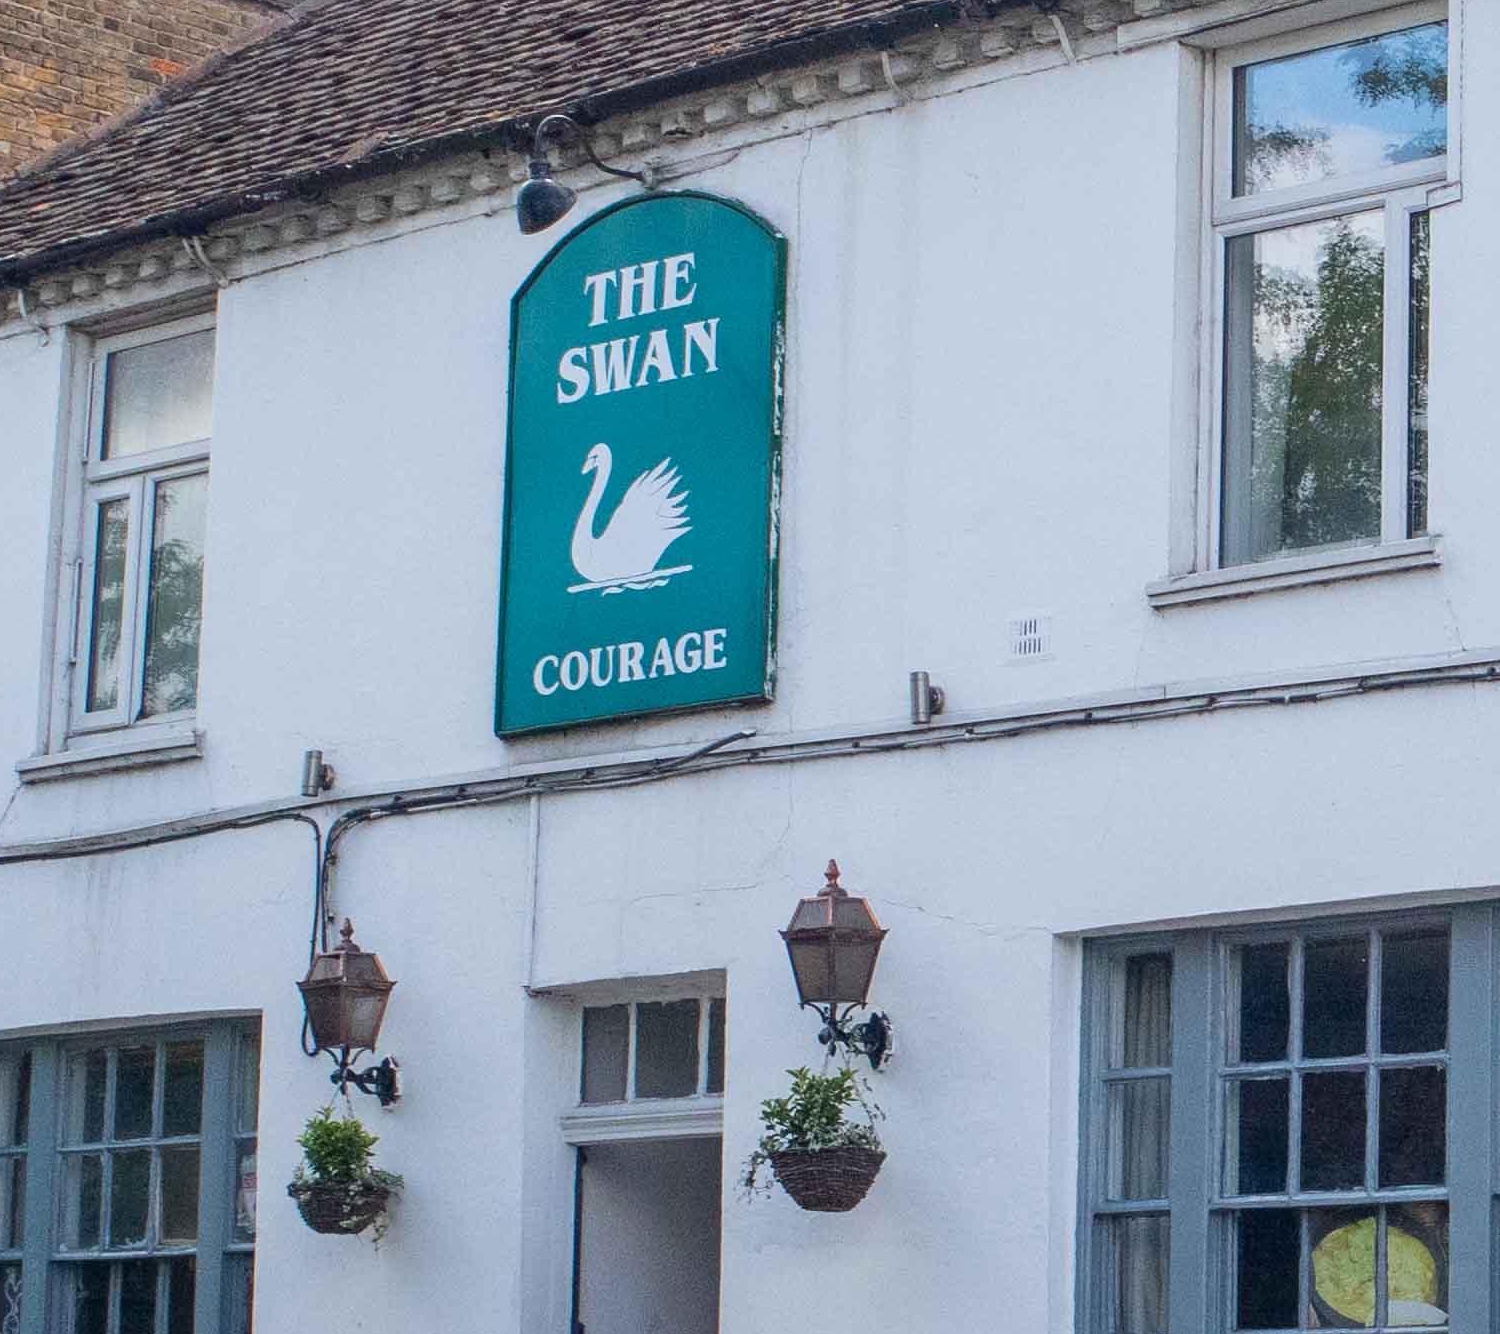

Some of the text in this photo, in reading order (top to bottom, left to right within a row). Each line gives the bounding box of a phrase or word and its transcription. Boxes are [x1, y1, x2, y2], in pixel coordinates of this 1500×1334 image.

[583, 253, 698, 328] THE
[556, 317, 721, 405] SWAN
[532, 628, 728, 696] COURAGE
